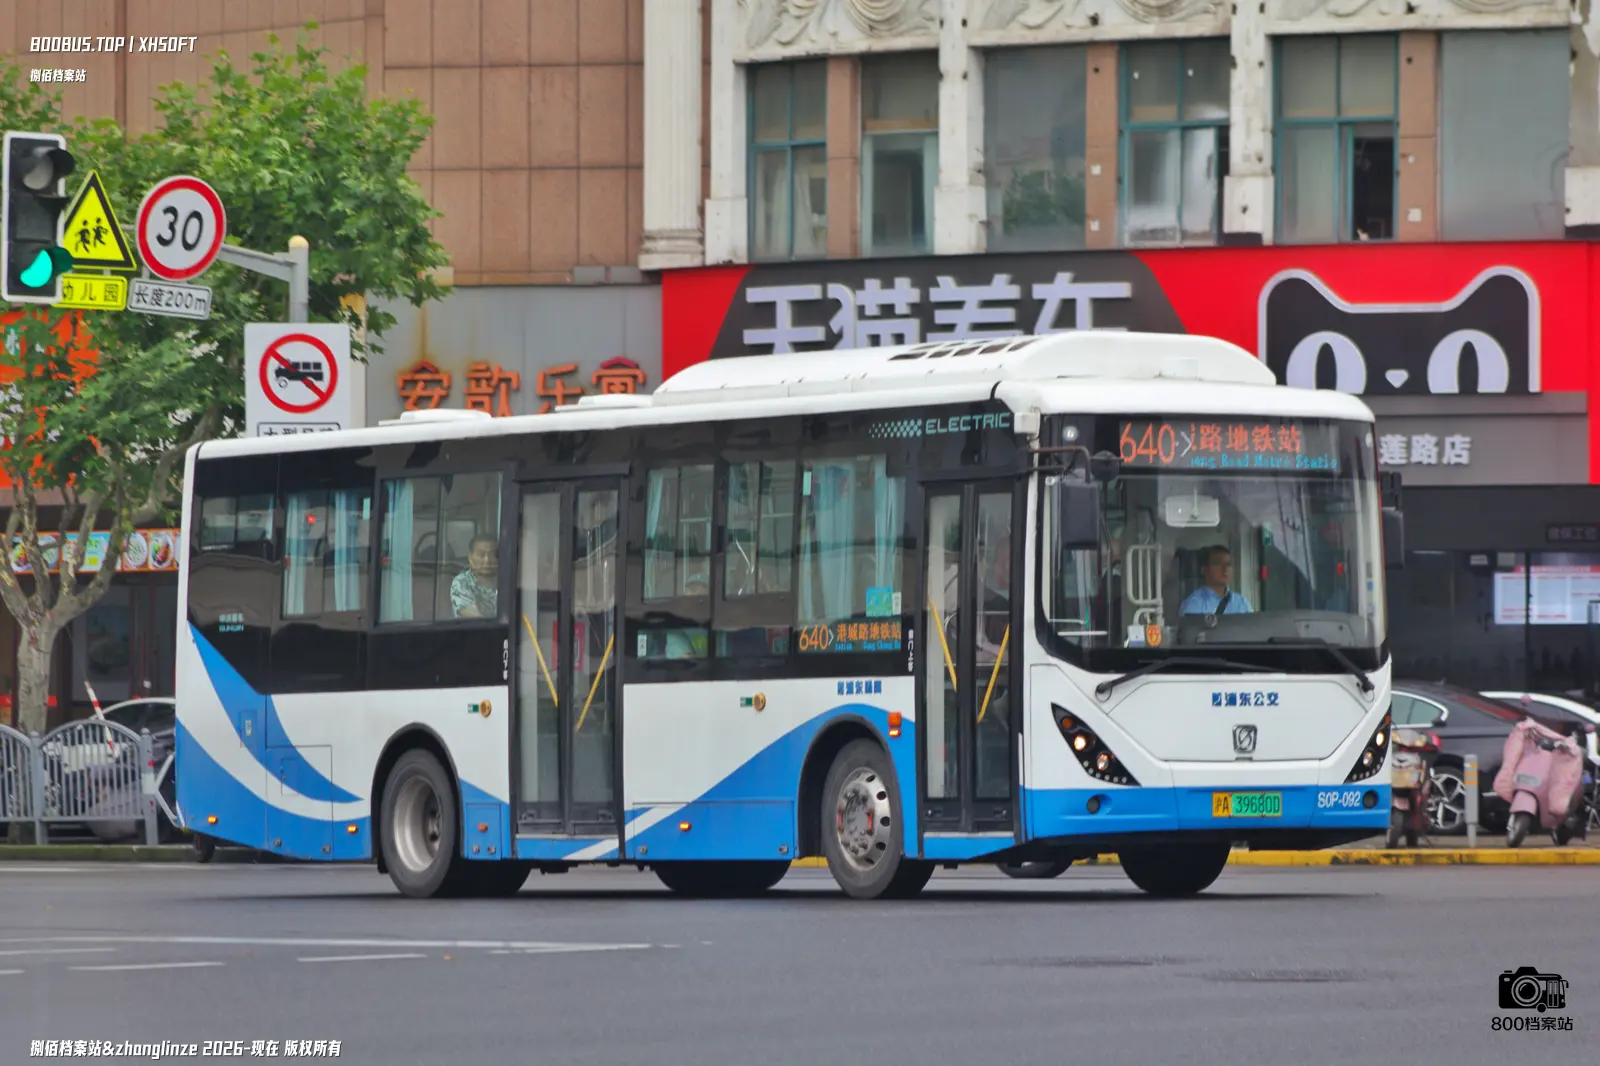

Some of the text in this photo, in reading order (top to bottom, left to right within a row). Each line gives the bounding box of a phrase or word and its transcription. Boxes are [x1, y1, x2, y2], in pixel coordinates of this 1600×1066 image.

[156, 206, 203, 251] 30
[62, 281, 119, 304] 幼儿园
[134, 284, 206, 312] 长度200m
[742, 271, 1132, 354] 天猫养车
[925, 412, 1010, 434] ELECTRIC
[1119, 422, 1302, 463] 640 路地铁站
[799, 624, 829, 652] 640
